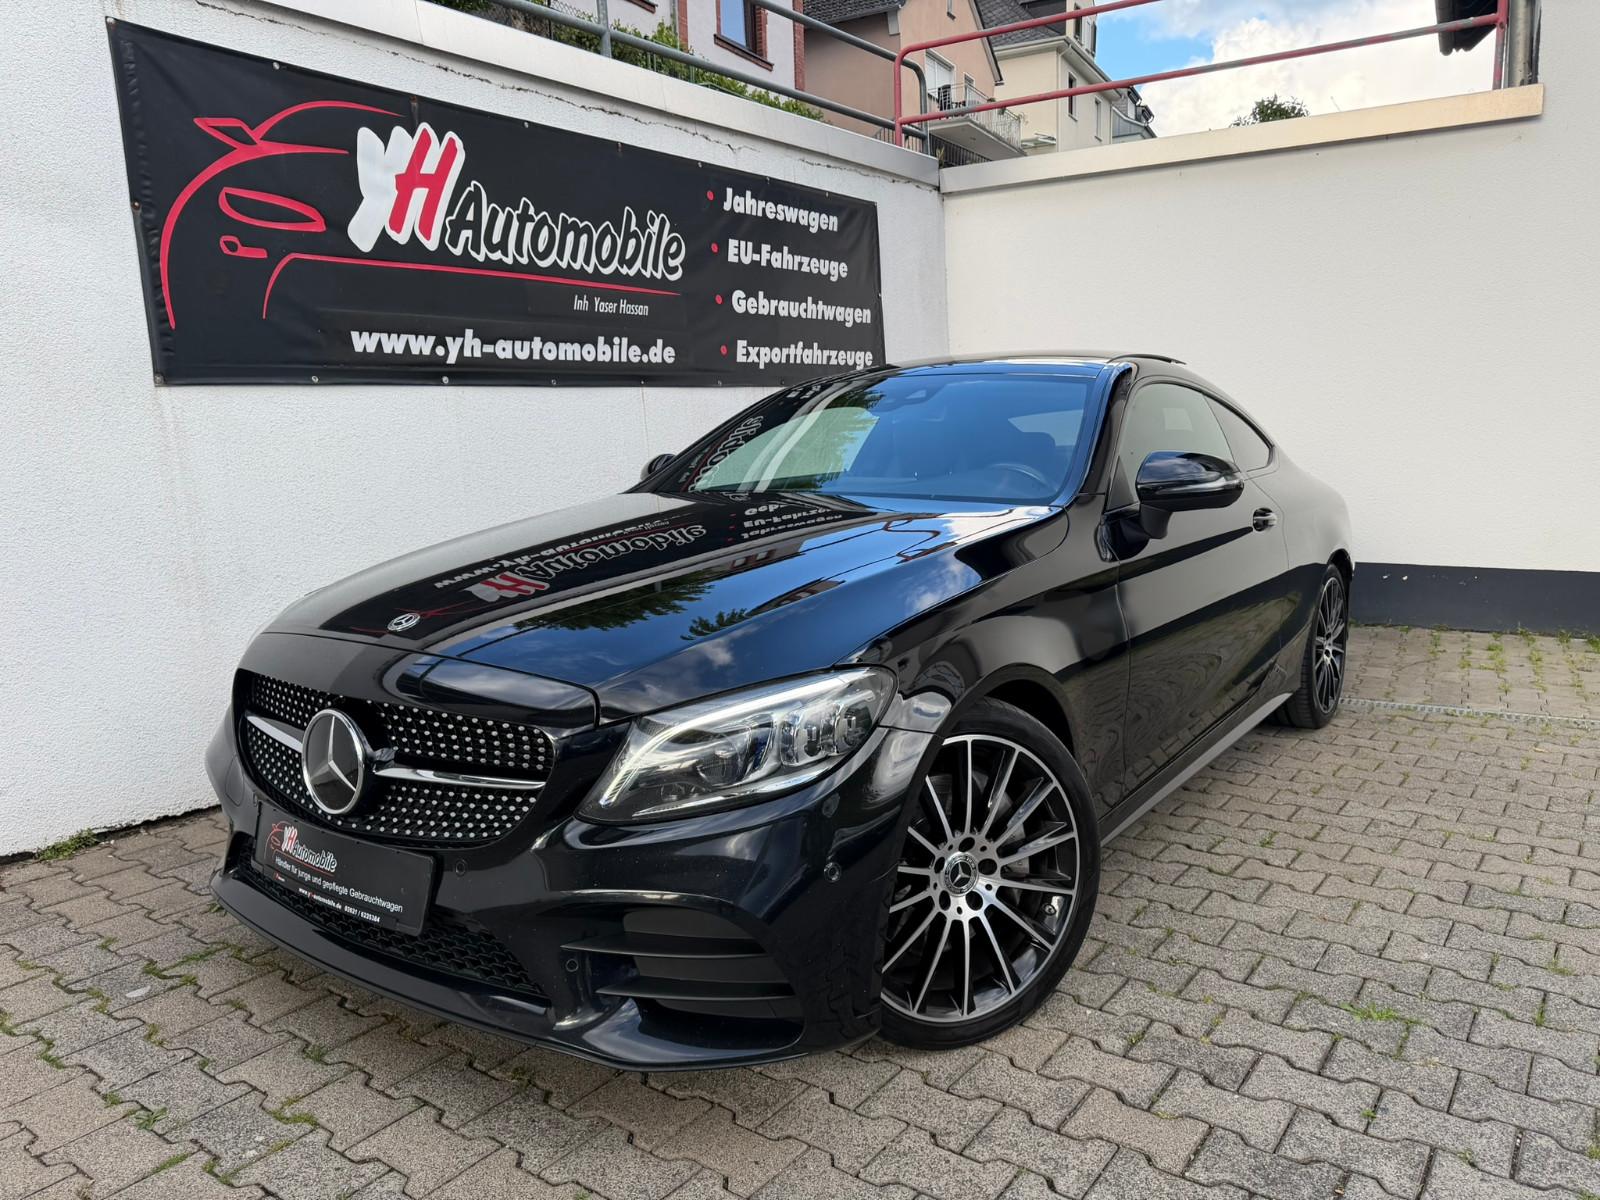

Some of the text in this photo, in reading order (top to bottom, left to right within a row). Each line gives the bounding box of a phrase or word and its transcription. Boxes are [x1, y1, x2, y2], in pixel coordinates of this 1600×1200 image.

[723, 187, 839, 234] Jahreswagen
[445, 180, 686, 282] Automobile
[727, 238, 849, 282] EU-Fahrzeuge
[573, 295, 649, 316] Inh Yaser Hassan
[731, 289, 872, 328] Gebrauchtwagen
[350, 328, 677, 364] www.yh-automobile.de
[736, 339, 874, 371] Exportfahrzeuge
[292, 840, 338, 873] Automobile
[298, 869, 312, 882] junge
[312, 875, 322, 886] und
[322, 879, 349, 896] gepflegte
[349, 888, 403, 913] Gebrauchtwagen
